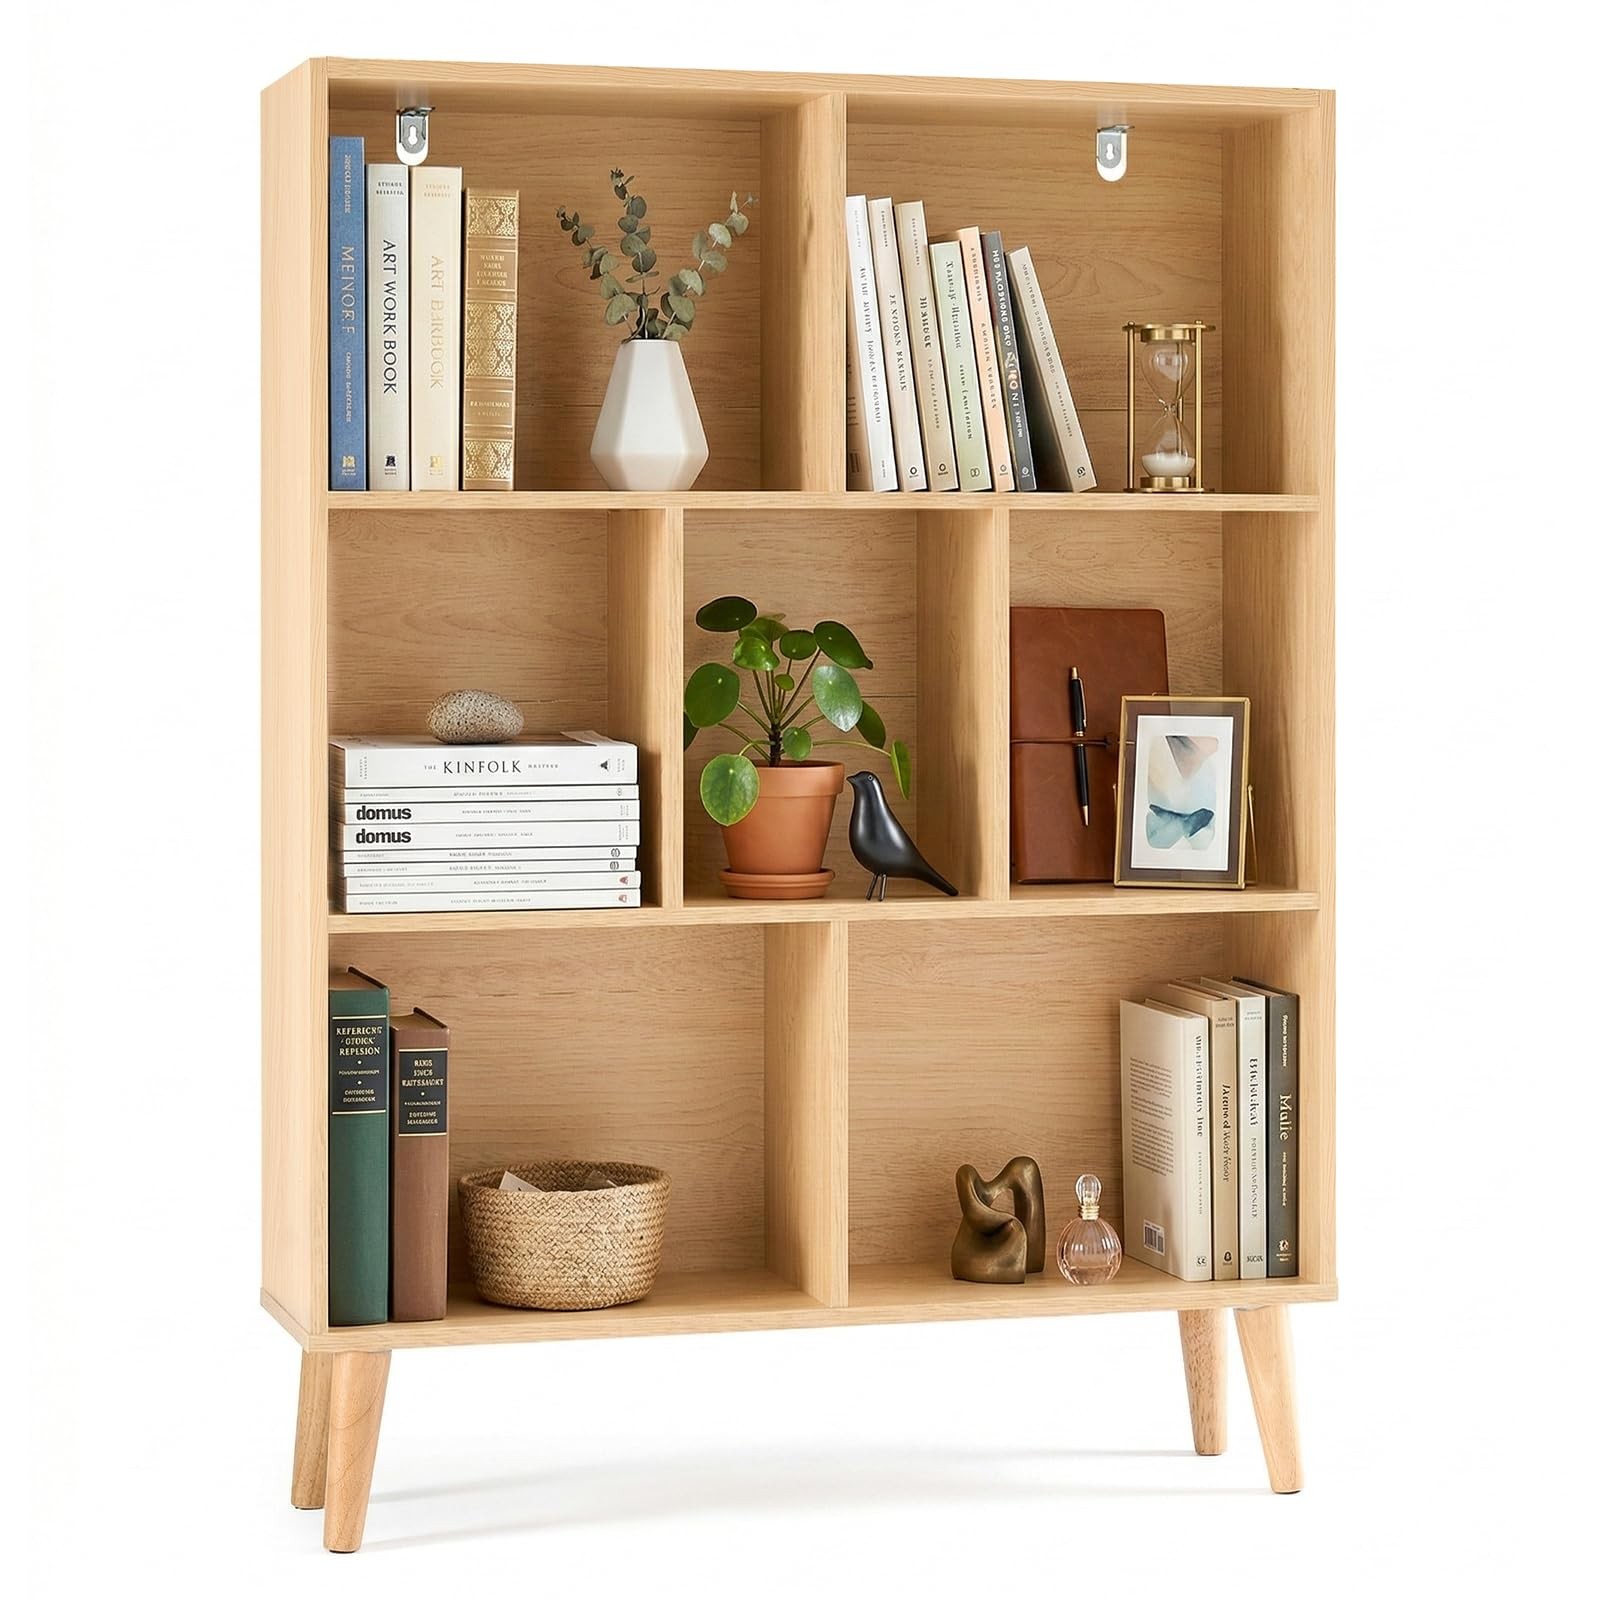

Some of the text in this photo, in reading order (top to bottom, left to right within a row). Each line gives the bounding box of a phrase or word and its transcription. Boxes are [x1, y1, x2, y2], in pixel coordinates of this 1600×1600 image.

[431, 255, 444, 291] ART
[383, 239, 397, 394] ART WORK BOOK
[443, 760, 521, 774] KINFOLK
[356, 805, 412, 820] domus
[355, 828, 412, 844] domus
